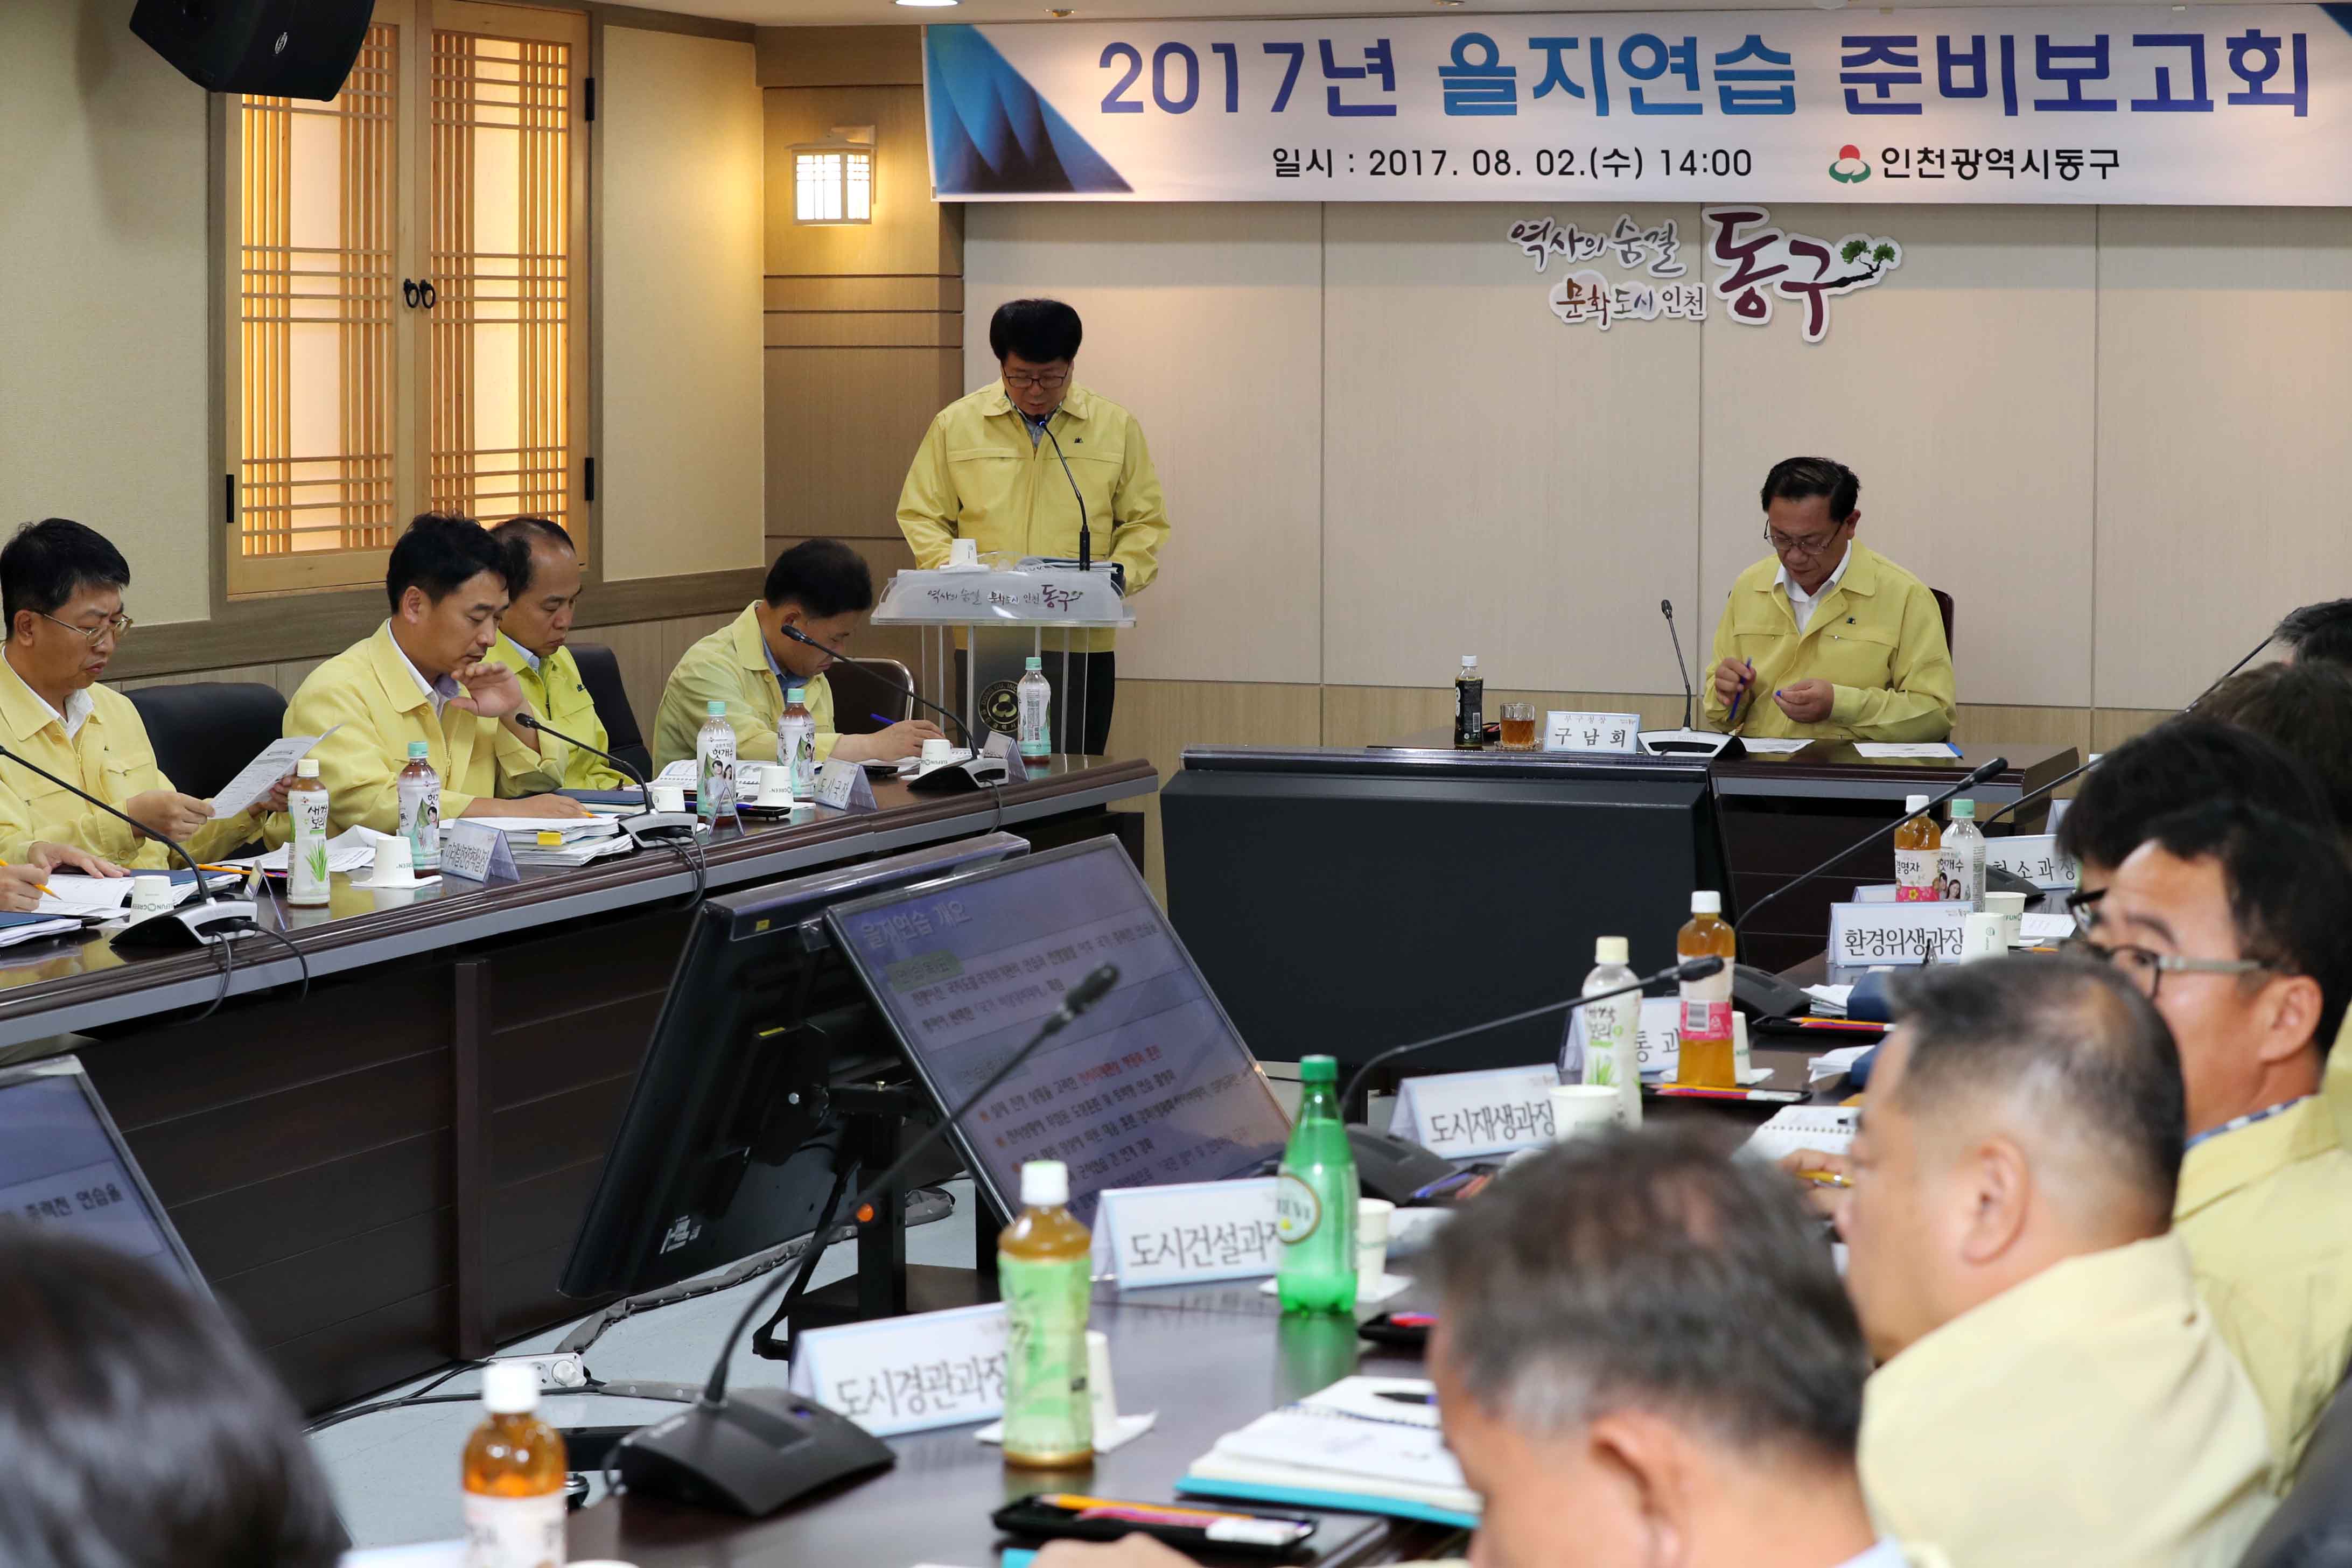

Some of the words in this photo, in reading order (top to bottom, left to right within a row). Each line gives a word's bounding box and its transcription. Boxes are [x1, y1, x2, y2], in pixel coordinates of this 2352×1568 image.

[1098, 38, 1397, 117] 2017년
[1438, 31, 1796, 116] 을지연습
[1838, 29, 2309, 118] 준비보고회
[1272, 146, 1334, 178] 일시
[1369, 148, 1459, 177] 2017.
[1472, 148, 1522, 177] 08.
[1536, 145, 1644, 181] 02.(수)
[1660, 148, 1753, 178] 14:00
[1881, 146, 2121, 181] 인천광역시동구
[1511, 220, 1605, 269] 역사의
[1613, 218, 1684, 274] 숨결
[1708, 211, 1852, 338] 동구
[1662, 285, 1707, 317] 인천
[1023, 592, 1040, 605] 인천
[1041, 584, 1078, 612] 동구
[1844, 927, 1964, 958] 환경위생과장
[1430, 1100, 1556, 1144] 도시재생과장
